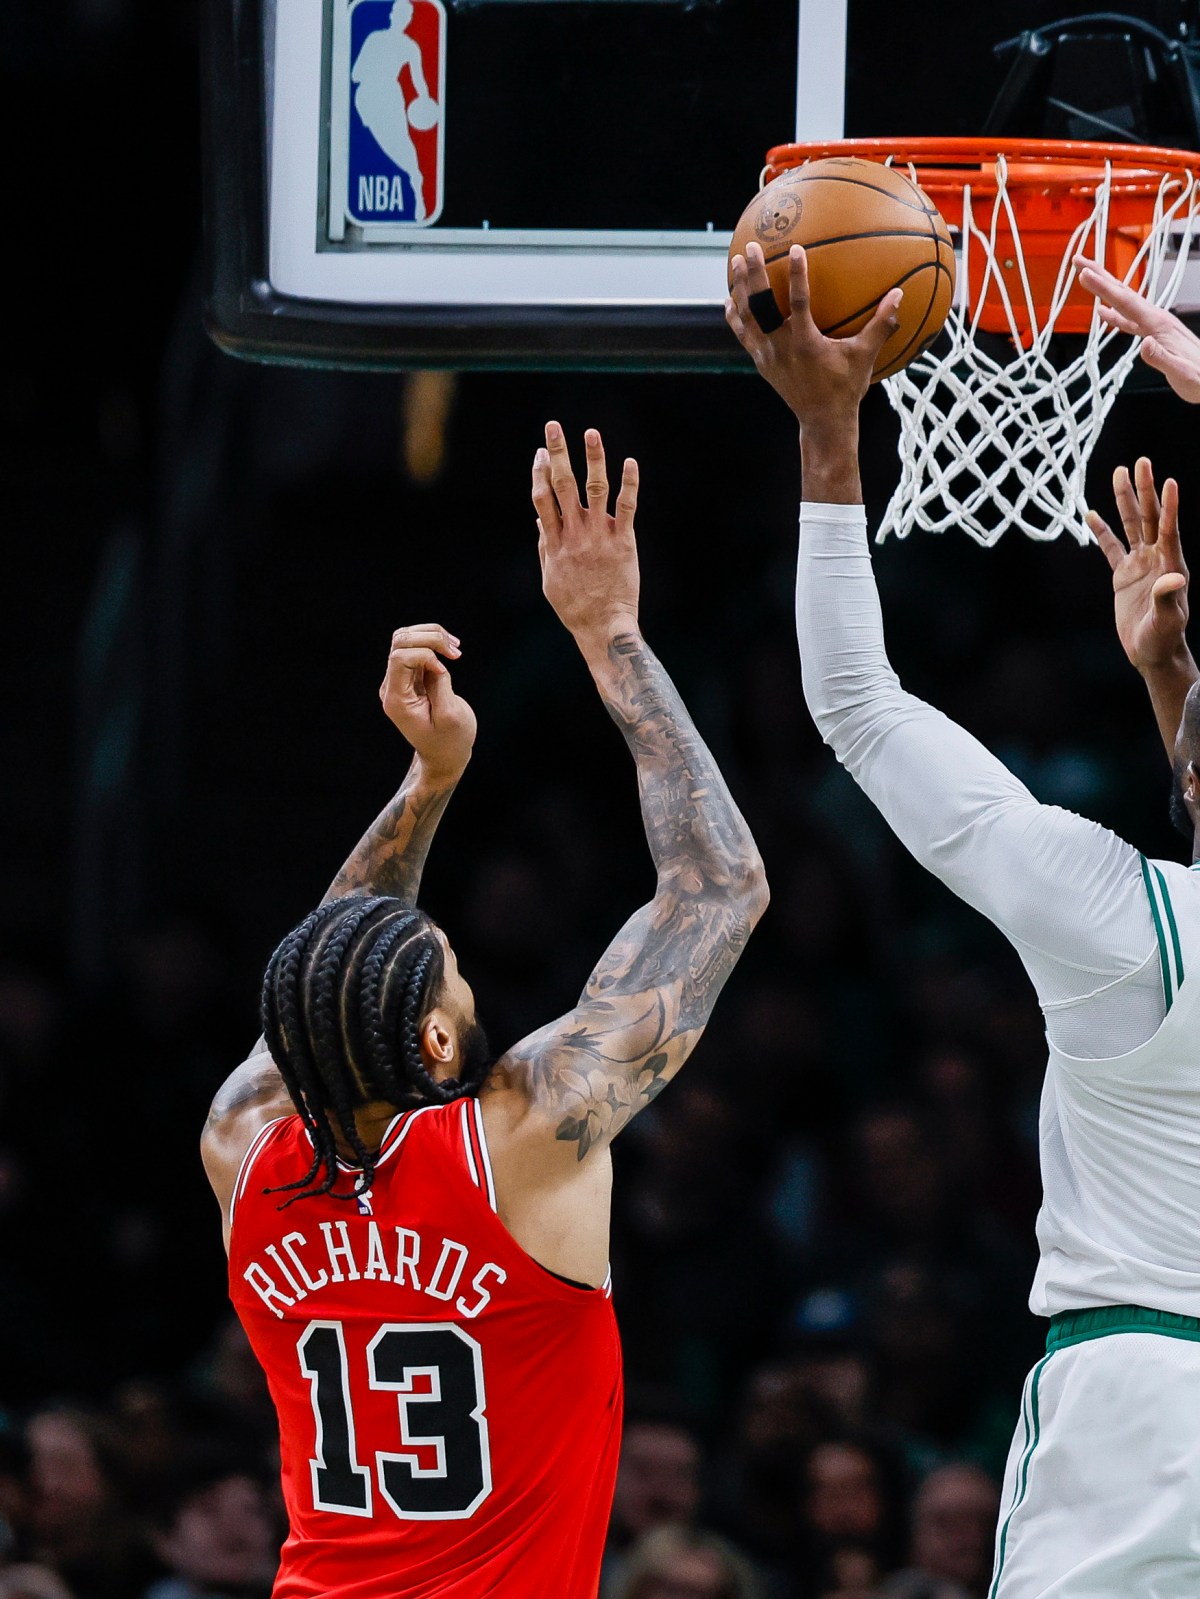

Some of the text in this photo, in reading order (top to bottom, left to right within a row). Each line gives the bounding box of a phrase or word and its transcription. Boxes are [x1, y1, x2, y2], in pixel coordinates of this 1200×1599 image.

[358, 175, 404, 212] NBA
[243, 1220, 507, 1319] RICHARDS
[296, 1319, 492, 1520] 13
